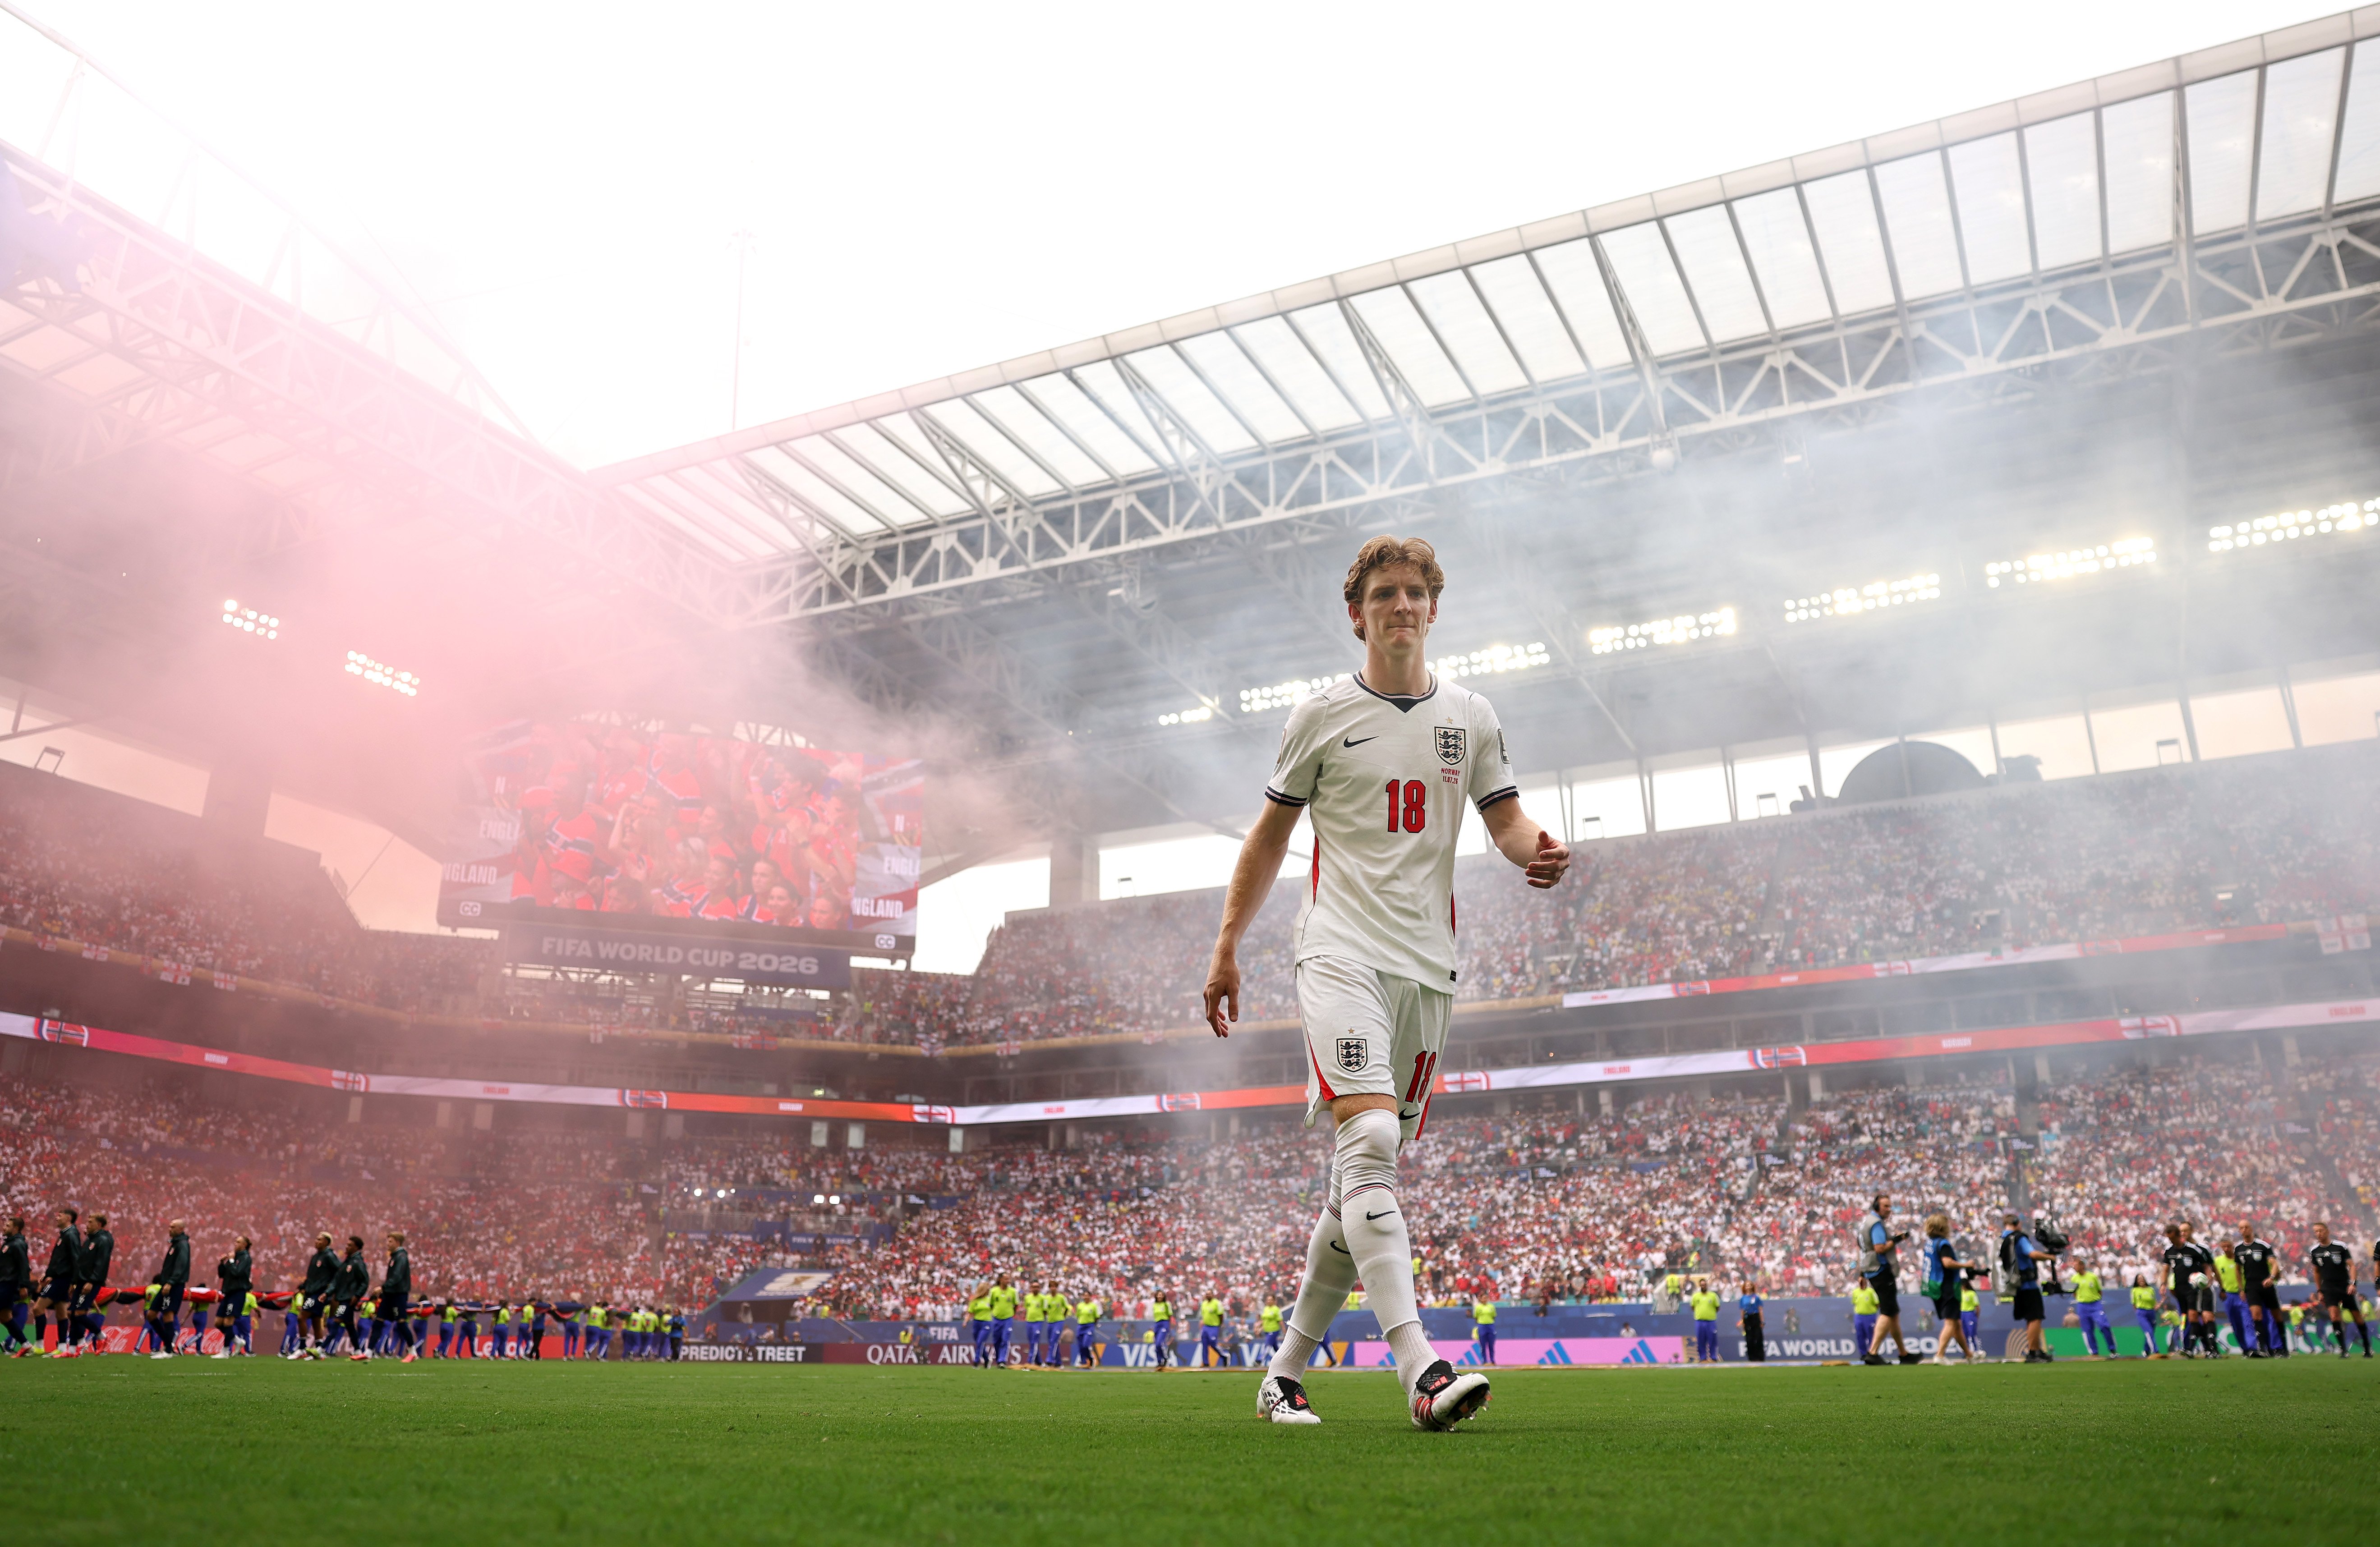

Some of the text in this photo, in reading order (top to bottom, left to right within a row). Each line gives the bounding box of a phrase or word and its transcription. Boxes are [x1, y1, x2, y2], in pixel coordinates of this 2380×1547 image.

[1441, 767, 1460, 776] NORWAY
[1442, 776, 1458, 784] 11.07.26
[1386, 779, 1426, 833] 18
[541, 937, 819, 975] FIFA WORLD CUP 2026
[1405, 1051, 1436, 1103] 18
[929, 1327, 959, 1341] FIFA
[866, 1345, 929, 1365] QATA
[1739, 1340, 1782, 1357] FA
[1782, 1339, 1856, 1356] WORLD
